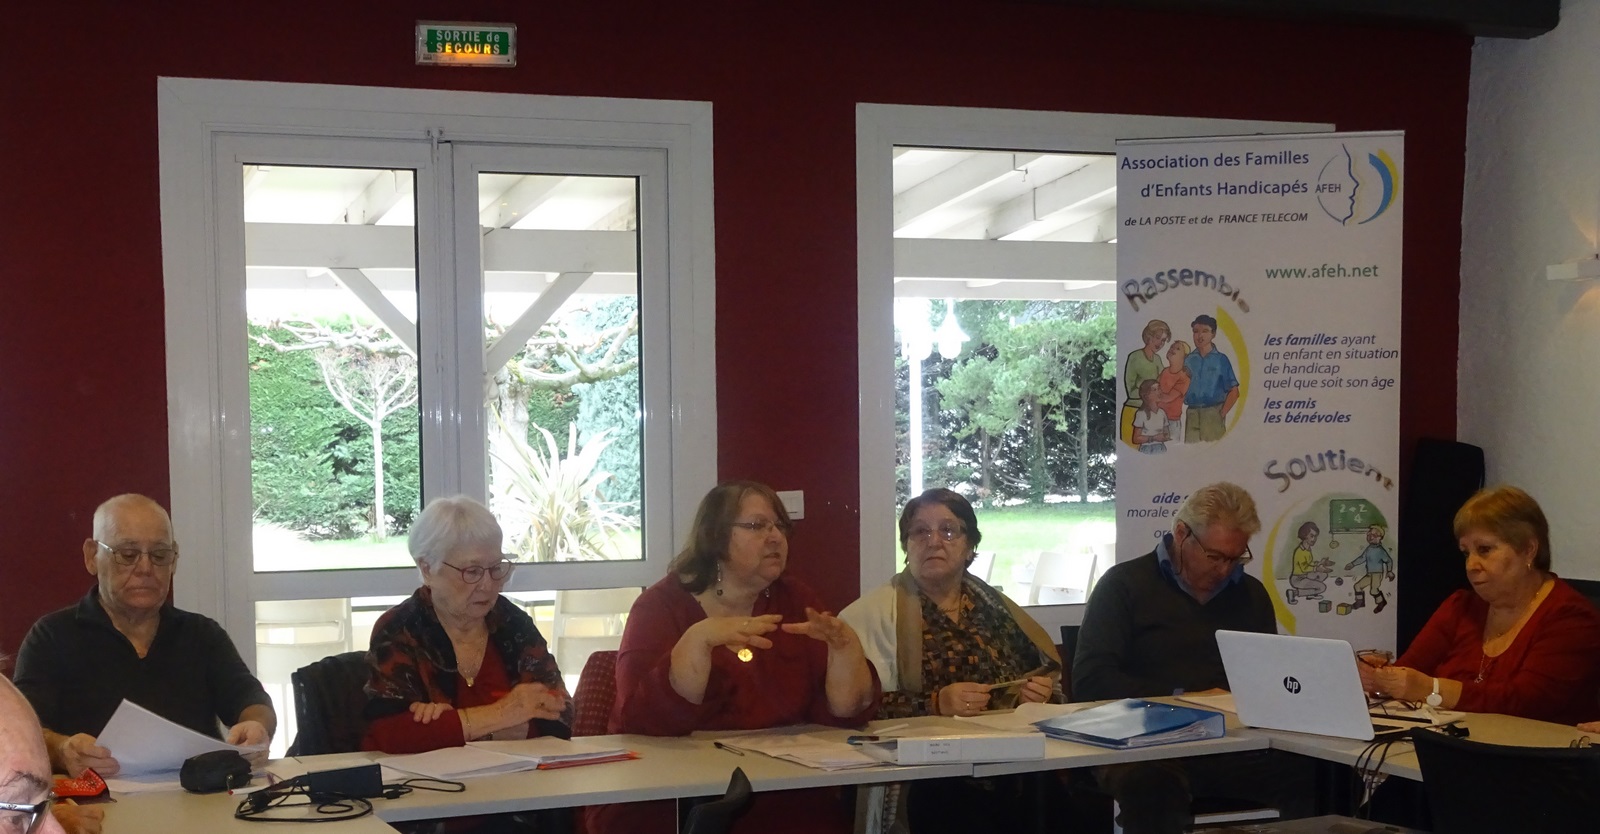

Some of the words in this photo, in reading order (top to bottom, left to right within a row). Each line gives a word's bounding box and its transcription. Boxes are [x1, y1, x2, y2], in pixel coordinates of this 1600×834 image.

[436, 30, 480, 41] SORTIE
[486, 32, 500, 42] de
[436, 42, 500, 55] SECOURS
[1121, 154, 1208, 170] Association
[1213, 153, 1240, 167] des
[1245, 151, 1309, 166] Familles
[1217, 180, 1308, 197] Handicapés
[1315, 183, 1341, 194] AFEH
[1124, 217, 1137, 226] de
[1139, 216, 1151, 226] LA
[1154, 216, 1186, 225] POSTE
[1188, 216, 1198, 225] et
[1201, 215, 1213, 224] de
[1218, 213, 1258, 224] FRANCE
[1261, 213, 1308, 223] TELECOM
[1265, 264, 1379, 279] www.afeh.net
[1263, 334, 1282, 346] les
[1285, 333, 1338, 346] familles
[1340, 334, 1376, 347] ayant
[1263, 351, 1280, 360] un
[1283, 348, 1323, 360] enfant
[1326, 351, 1341, 360] en
[1345, 348, 1398, 360] situation
[1263, 363, 1280, 374] de
[1282, 362, 1340, 376] handicap
[1263, 377, 1291, 391] quel
[1293, 379, 1318, 390] que
[1320, 376, 1343, 388] soit
[1346, 378, 1368, 387] son
[1371, 376, 1395, 390] âge
[1263, 397, 1282, 410] les
[1284, 397, 1317, 409] amis
[1263, 411, 1282, 423] les
[1284, 411, 1352, 423] bénévoles
[1152, 492, 1181, 504] aide
[1126, 506, 1170, 518] morale
[1153, 530, 1172, 539] or
[1286, 675, 1299, 695] hp
